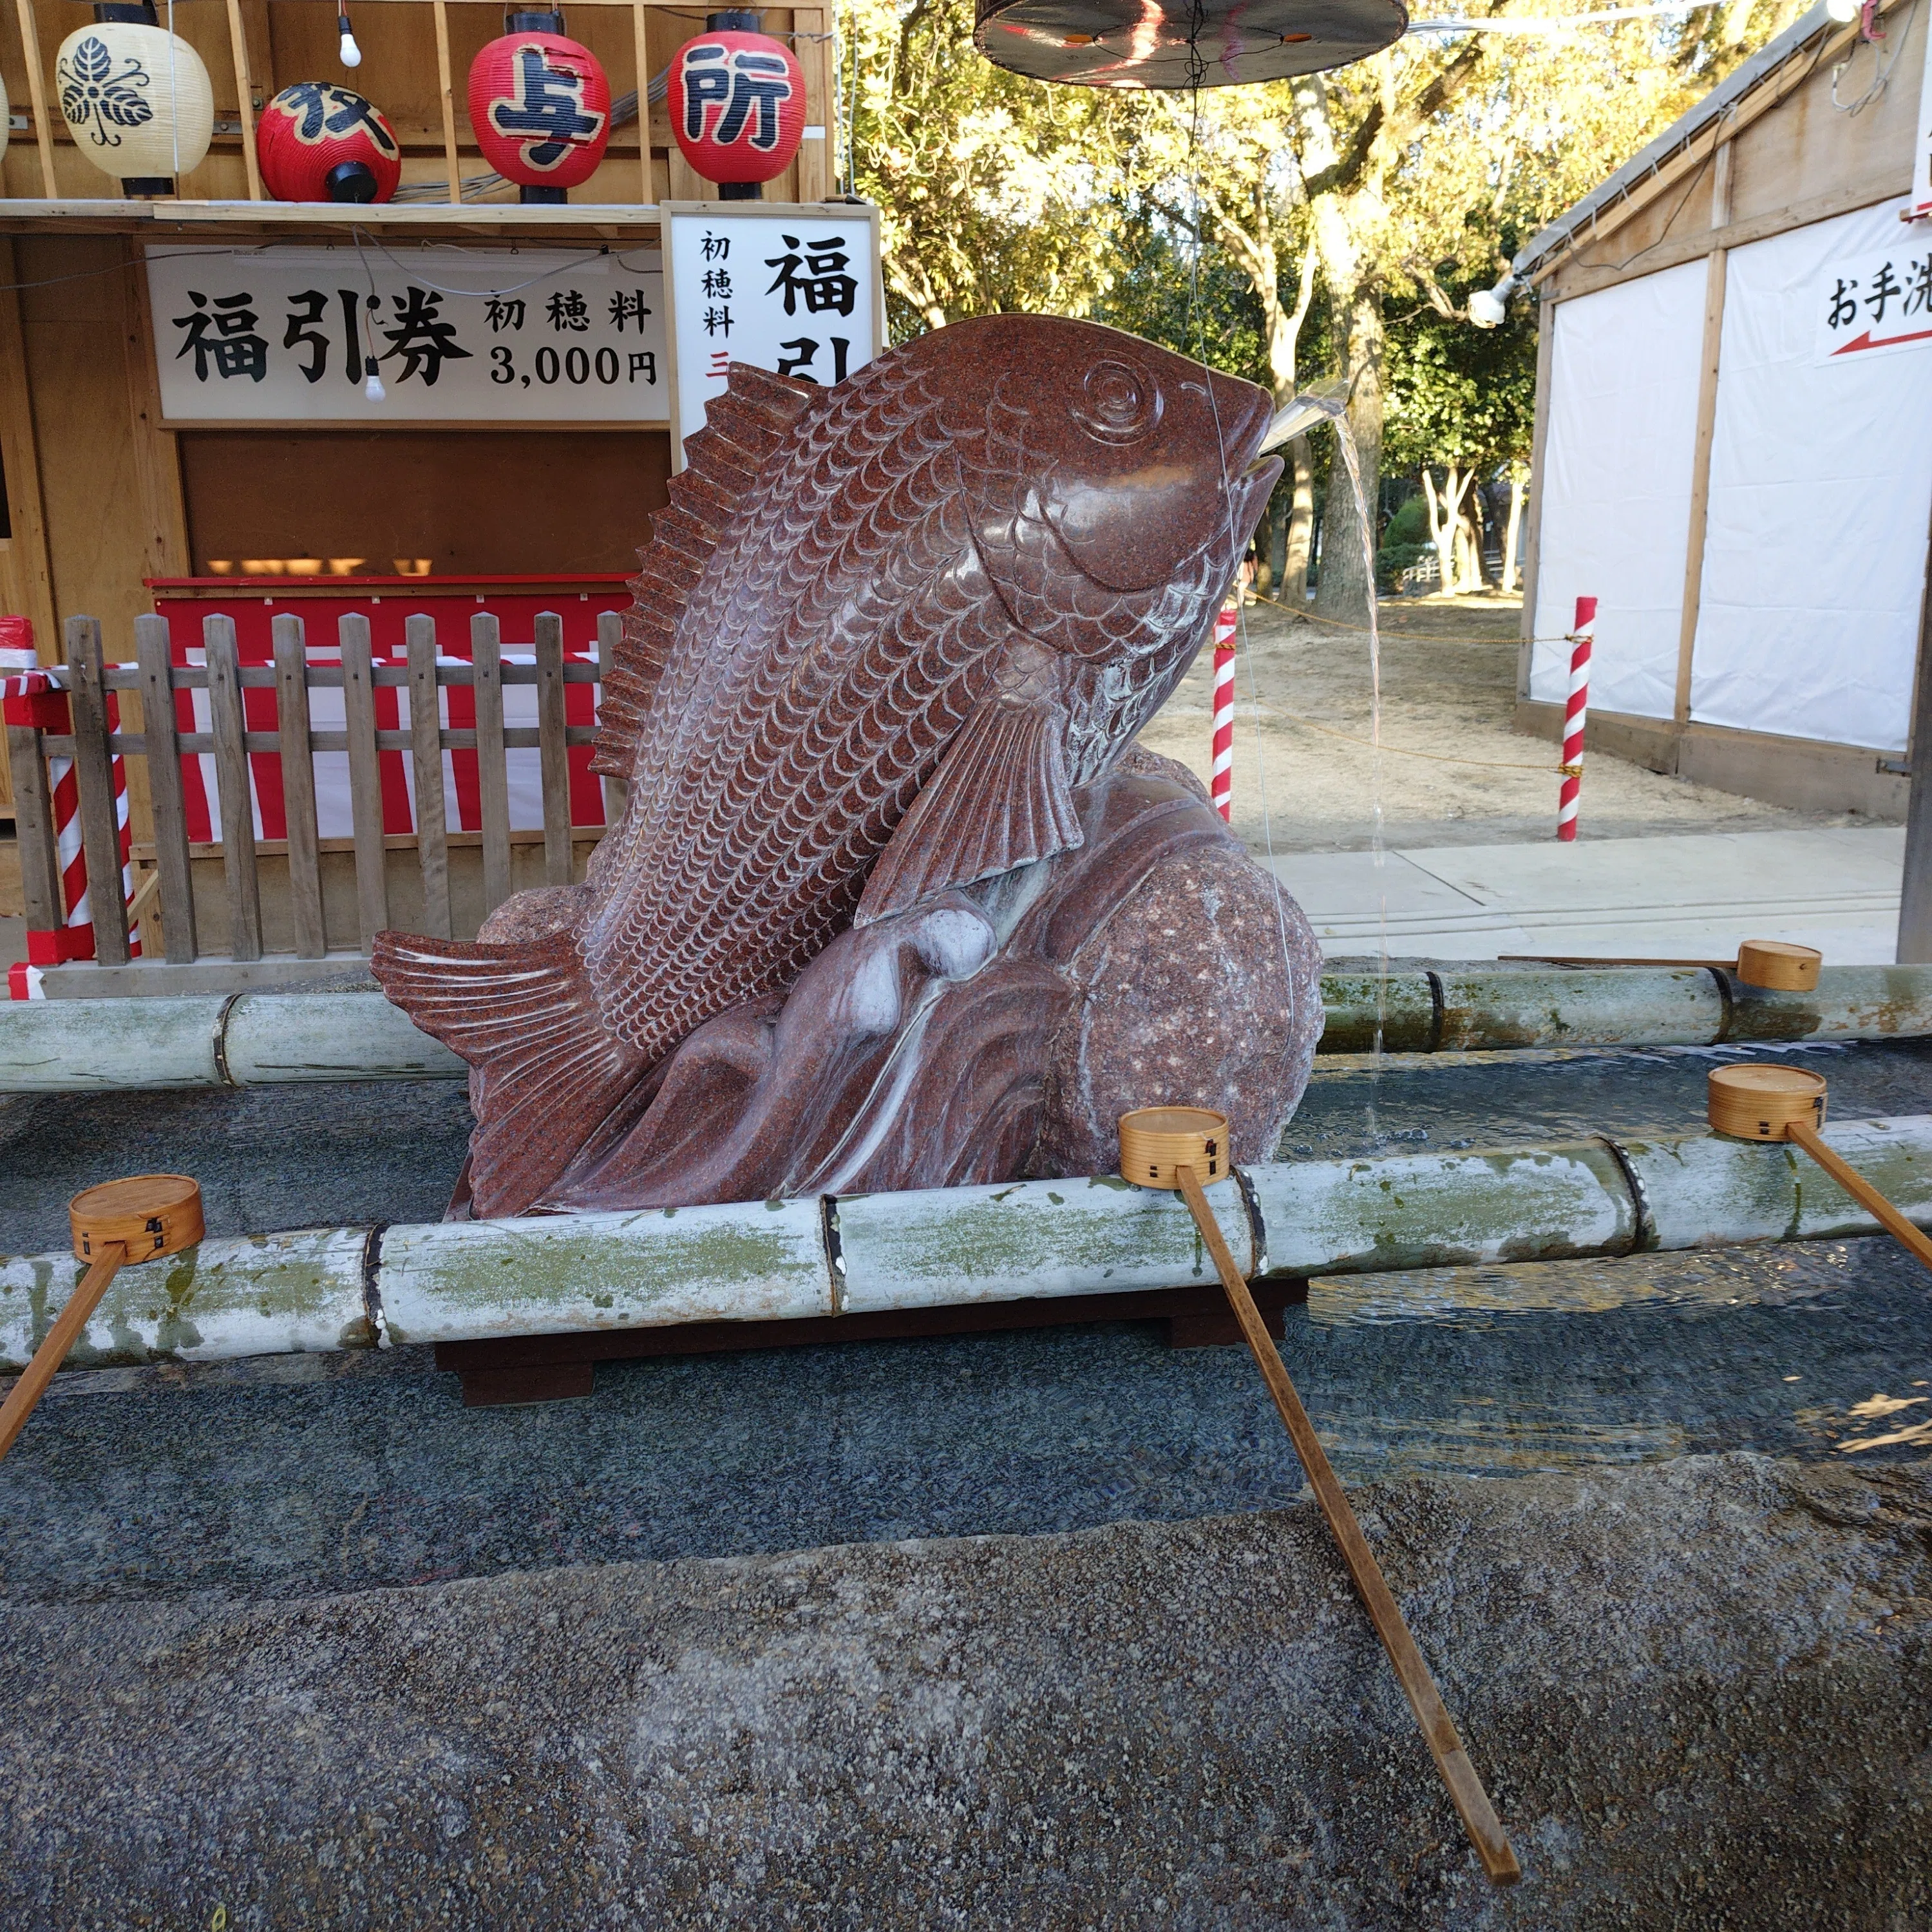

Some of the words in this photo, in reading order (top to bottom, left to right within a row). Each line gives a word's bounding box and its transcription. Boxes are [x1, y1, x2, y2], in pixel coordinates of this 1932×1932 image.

[681, 45, 791, 150] 所
[172, 286, 474, 386] 福引券
[484, 289, 652, 335] 初穂料
[490, 346, 656, 389] 3,000円
